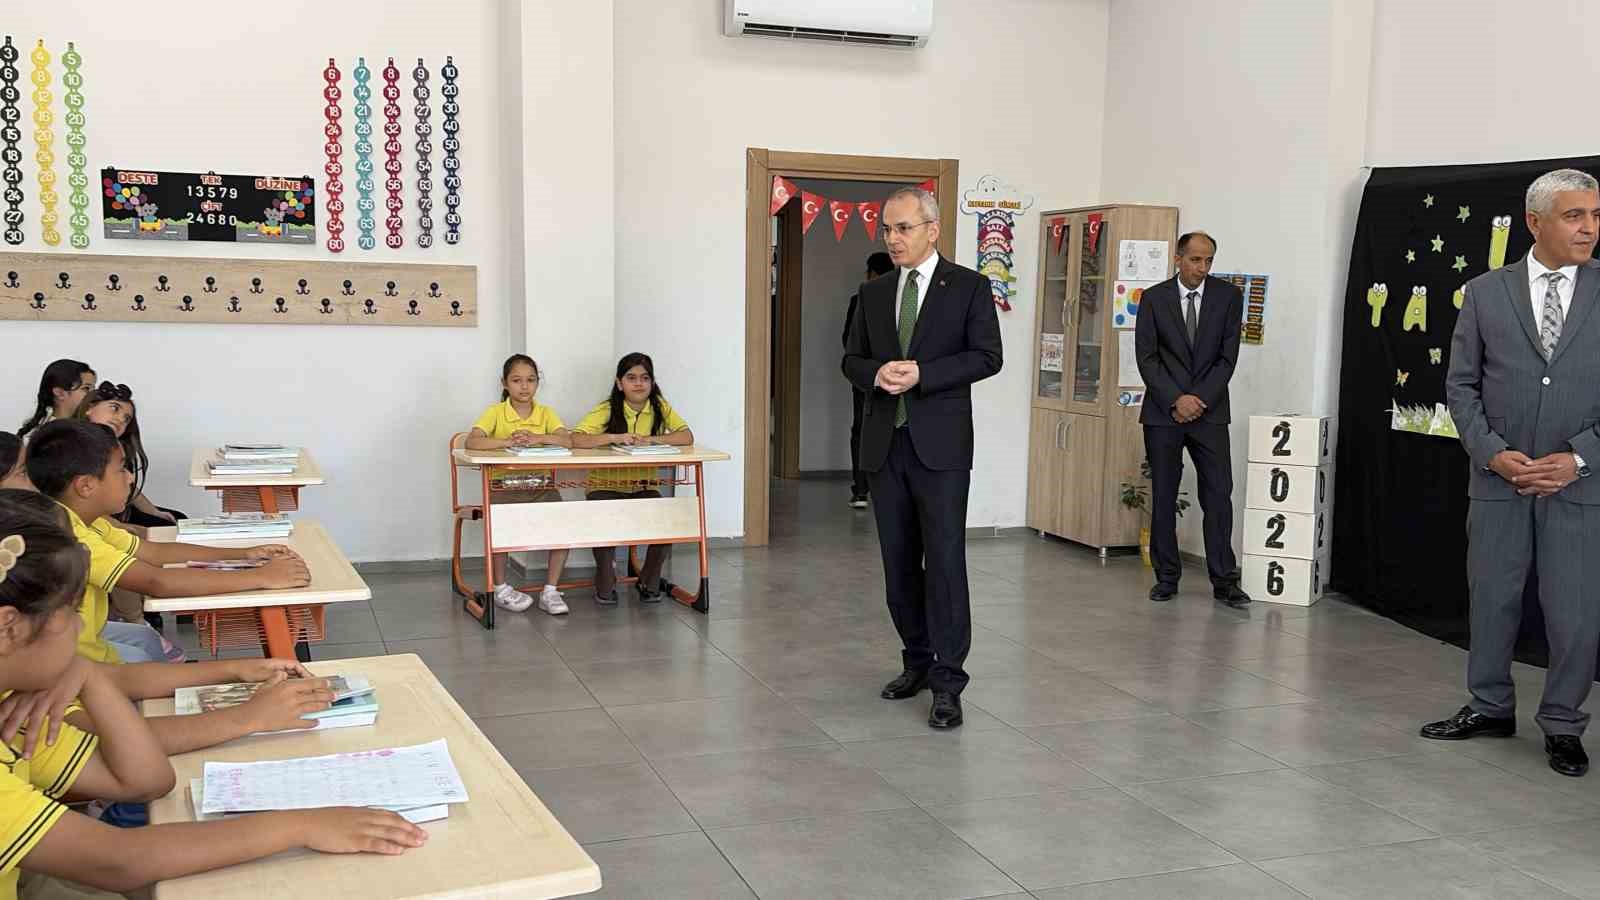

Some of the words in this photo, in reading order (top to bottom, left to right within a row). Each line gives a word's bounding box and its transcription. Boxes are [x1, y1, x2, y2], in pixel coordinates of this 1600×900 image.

[4, 48, 13, 59] 3
[68, 53, 76, 64] 5
[4, 68, 13, 80] 6
[328, 68, 336, 80] 6
[358, 68, 366, 79] 7
[387, 68, 395, 79] 8
[417, 68, 425, 80] 9
[446, 66, 455, 78] 10
[66, 74, 80, 86] 10
[6, 88, 15, 100] 9
[328, 88, 338, 99] 12
[388, 88, 398, 98] 16
[417, 88, 428, 98] 18
[444, 85, 457, 96] 20
[70, 94, 82, 106] 15
[5, 108, 17, 120] 12
[386, 106, 398, 116] 24
[416, 106, 430, 116] 27
[444, 104, 457, 114] 30
[68, 112, 84, 124] 20
[357, 124, 370, 134] 28
[386, 124, 400, 135] 32
[416, 124, 430, 134] 36
[444, 120, 458, 131] 40
[6, 128, 18, 140] 15
[69, 133, 84, 146] 25
[326, 144, 340, 155] 30
[358, 144, 371, 154] 35
[386, 142, 400, 152] 40
[416, 142, 431, 153] 45
[444, 139, 458, 150] 50
[6, 150, 18, 162] 18
[70, 154, 85, 166] 30
[326, 162, 340, 174] 36
[356, 162, 371, 172] 42
[386, 162, 400, 172] 48
[418, 160, 431, 172] 54
[445, 158, 459, 169] 60
[6, 170, 19, 182] 21
[70, 174, 86, 186] 35
[118, 172, 158, 184] DESTE
[201, 175, 222, 186] TEK
[446, 176, 460, 187] 70
[255, 177, 302, 191] DÜZİNE
[328, 182, 342, 192] 42
[359, 180, 372, 191] 49
[386, 180, 401, 191] 56
[419, 180, 432, 190] 63
[6, 190, 21, 201] 24
[70, 194, 88, 206] 40
[447, 195, 459, 206] 80
[328, 202, 342, 212] 48
[388, 198, 402, 209] 64
[420, 198, 432, 209] 72
[6, 210, 22, 222] 27
[71, 215, 87, 226] 45
[446, 214, 460, 224] 90
[328, 220, 342, 232] 54
[360, 219, 374, 230] 63
[388, 218, 401, 228] 72
[6, 231, 22, 242] 30
[72, 234, 88, 246] 50
[388, 235, 401, 246] 80
[419, 235, 432, 246] 90
[328, 239, 342, 250] 60
[360, 238, 374, 248] 70
[1272, 421, 1291, 456] 2
[1270, 468, 1289, 502] 0
[1264, 514, 1286, 548] 2
[1266, 560, 1284, 596] 6
